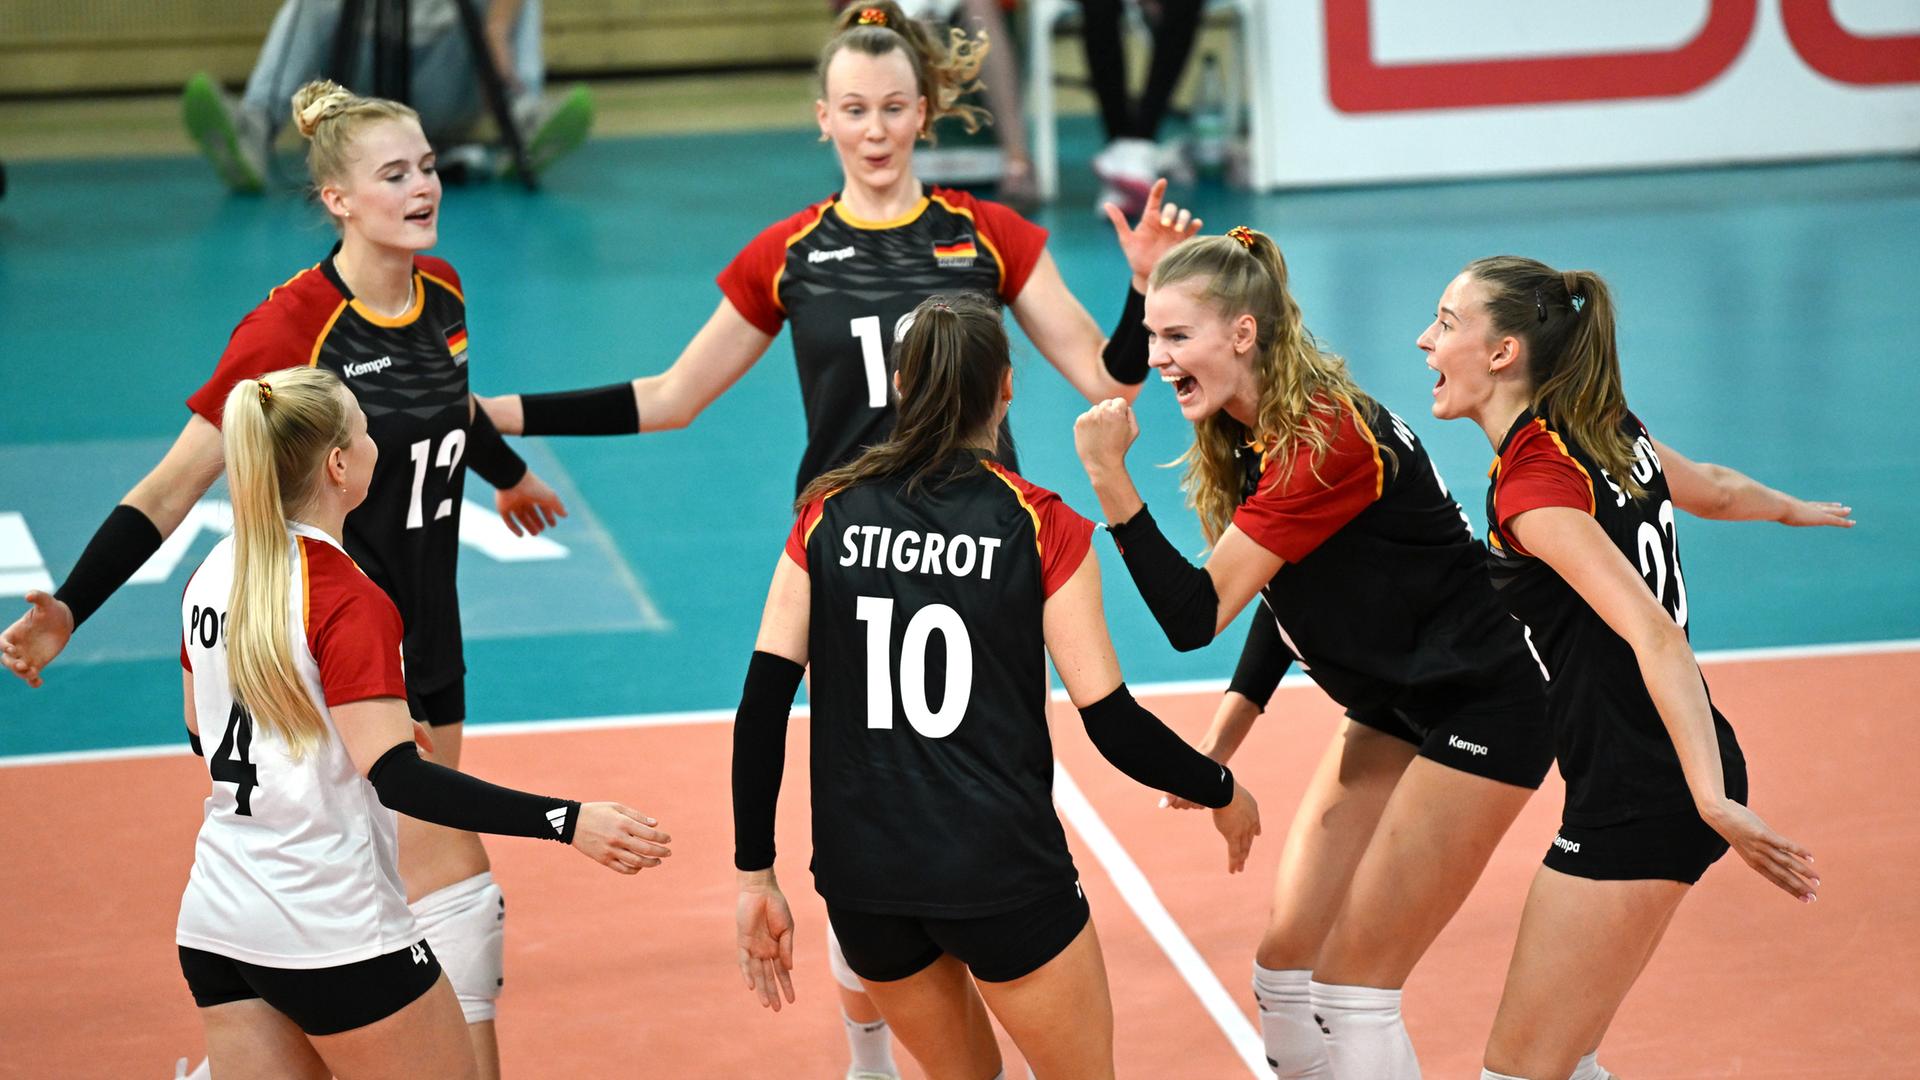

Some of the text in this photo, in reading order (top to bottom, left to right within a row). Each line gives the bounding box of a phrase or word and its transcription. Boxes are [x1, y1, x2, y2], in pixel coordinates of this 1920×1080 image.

[343, 356, 392, 378] Kempa
[850, 311, 916, 407] 1
[406, 428, 466, 530] 12
[839, 525, 1001, 580] STIGROT
[856, 595, 973, 739] 10
[210, 688, 259, 817] 4
[1449, 734, 1488, 756] Kempa
[410, 943, 429, 966] 4
